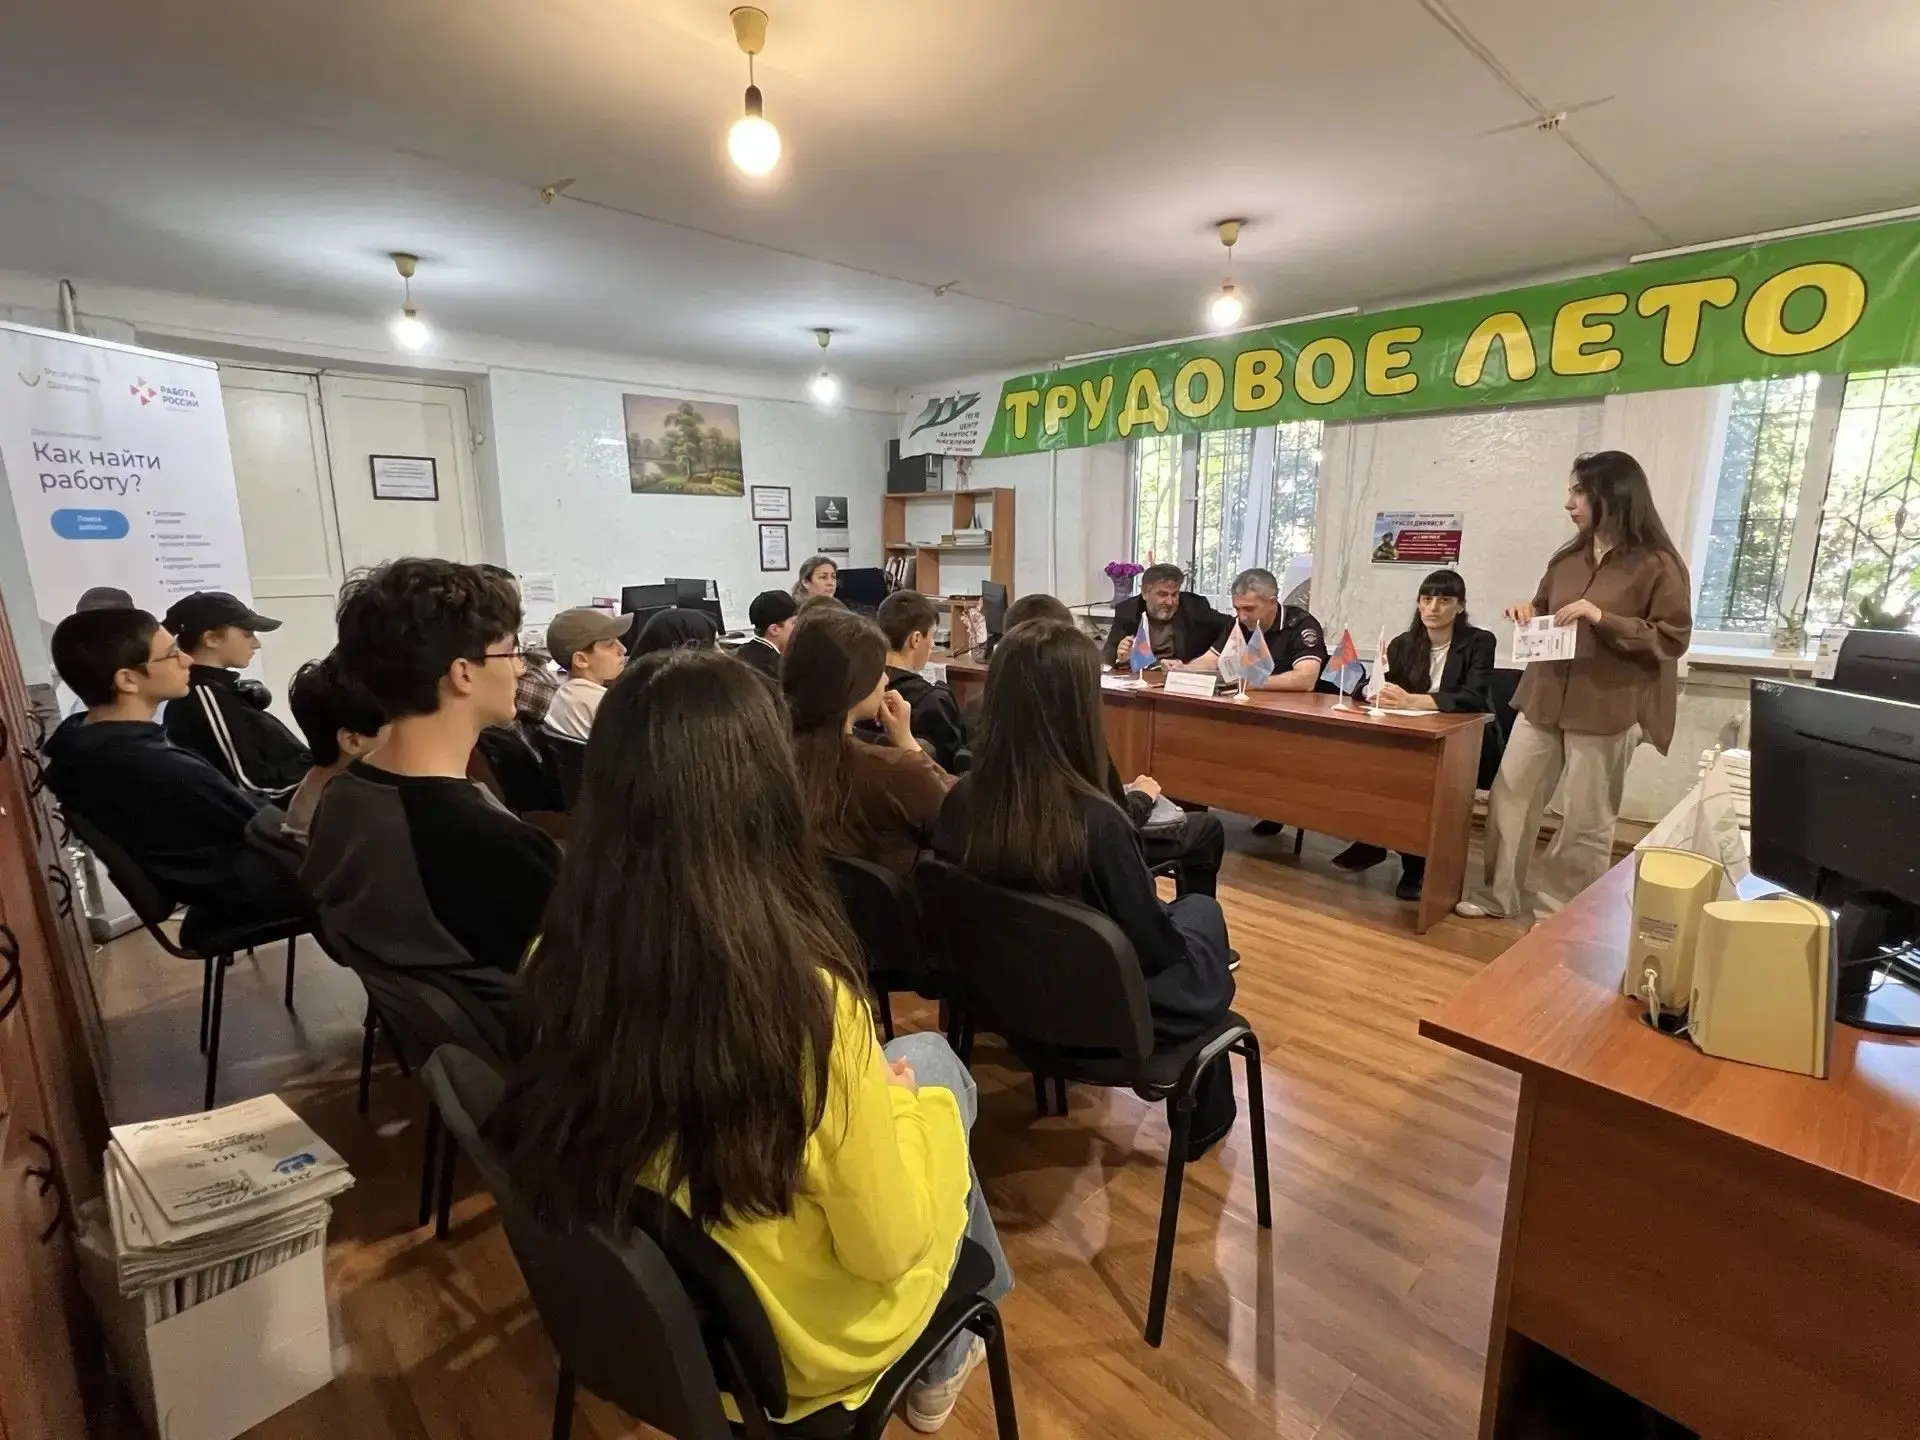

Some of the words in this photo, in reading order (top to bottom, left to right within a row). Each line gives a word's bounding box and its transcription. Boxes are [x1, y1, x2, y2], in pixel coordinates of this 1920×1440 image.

[1004, 325, 1424, 440] ТРУДОВОЕ
[1453, 260, 1868, 388] ЛЕТО
[160, 385, 196, 398] РАБОТА
[162, 396, 199, 408] РОССИИ
[33, 441, 83, 465] Как
[89, 448, 161, 470] найти
[39, 469, 141, 496] работу?
